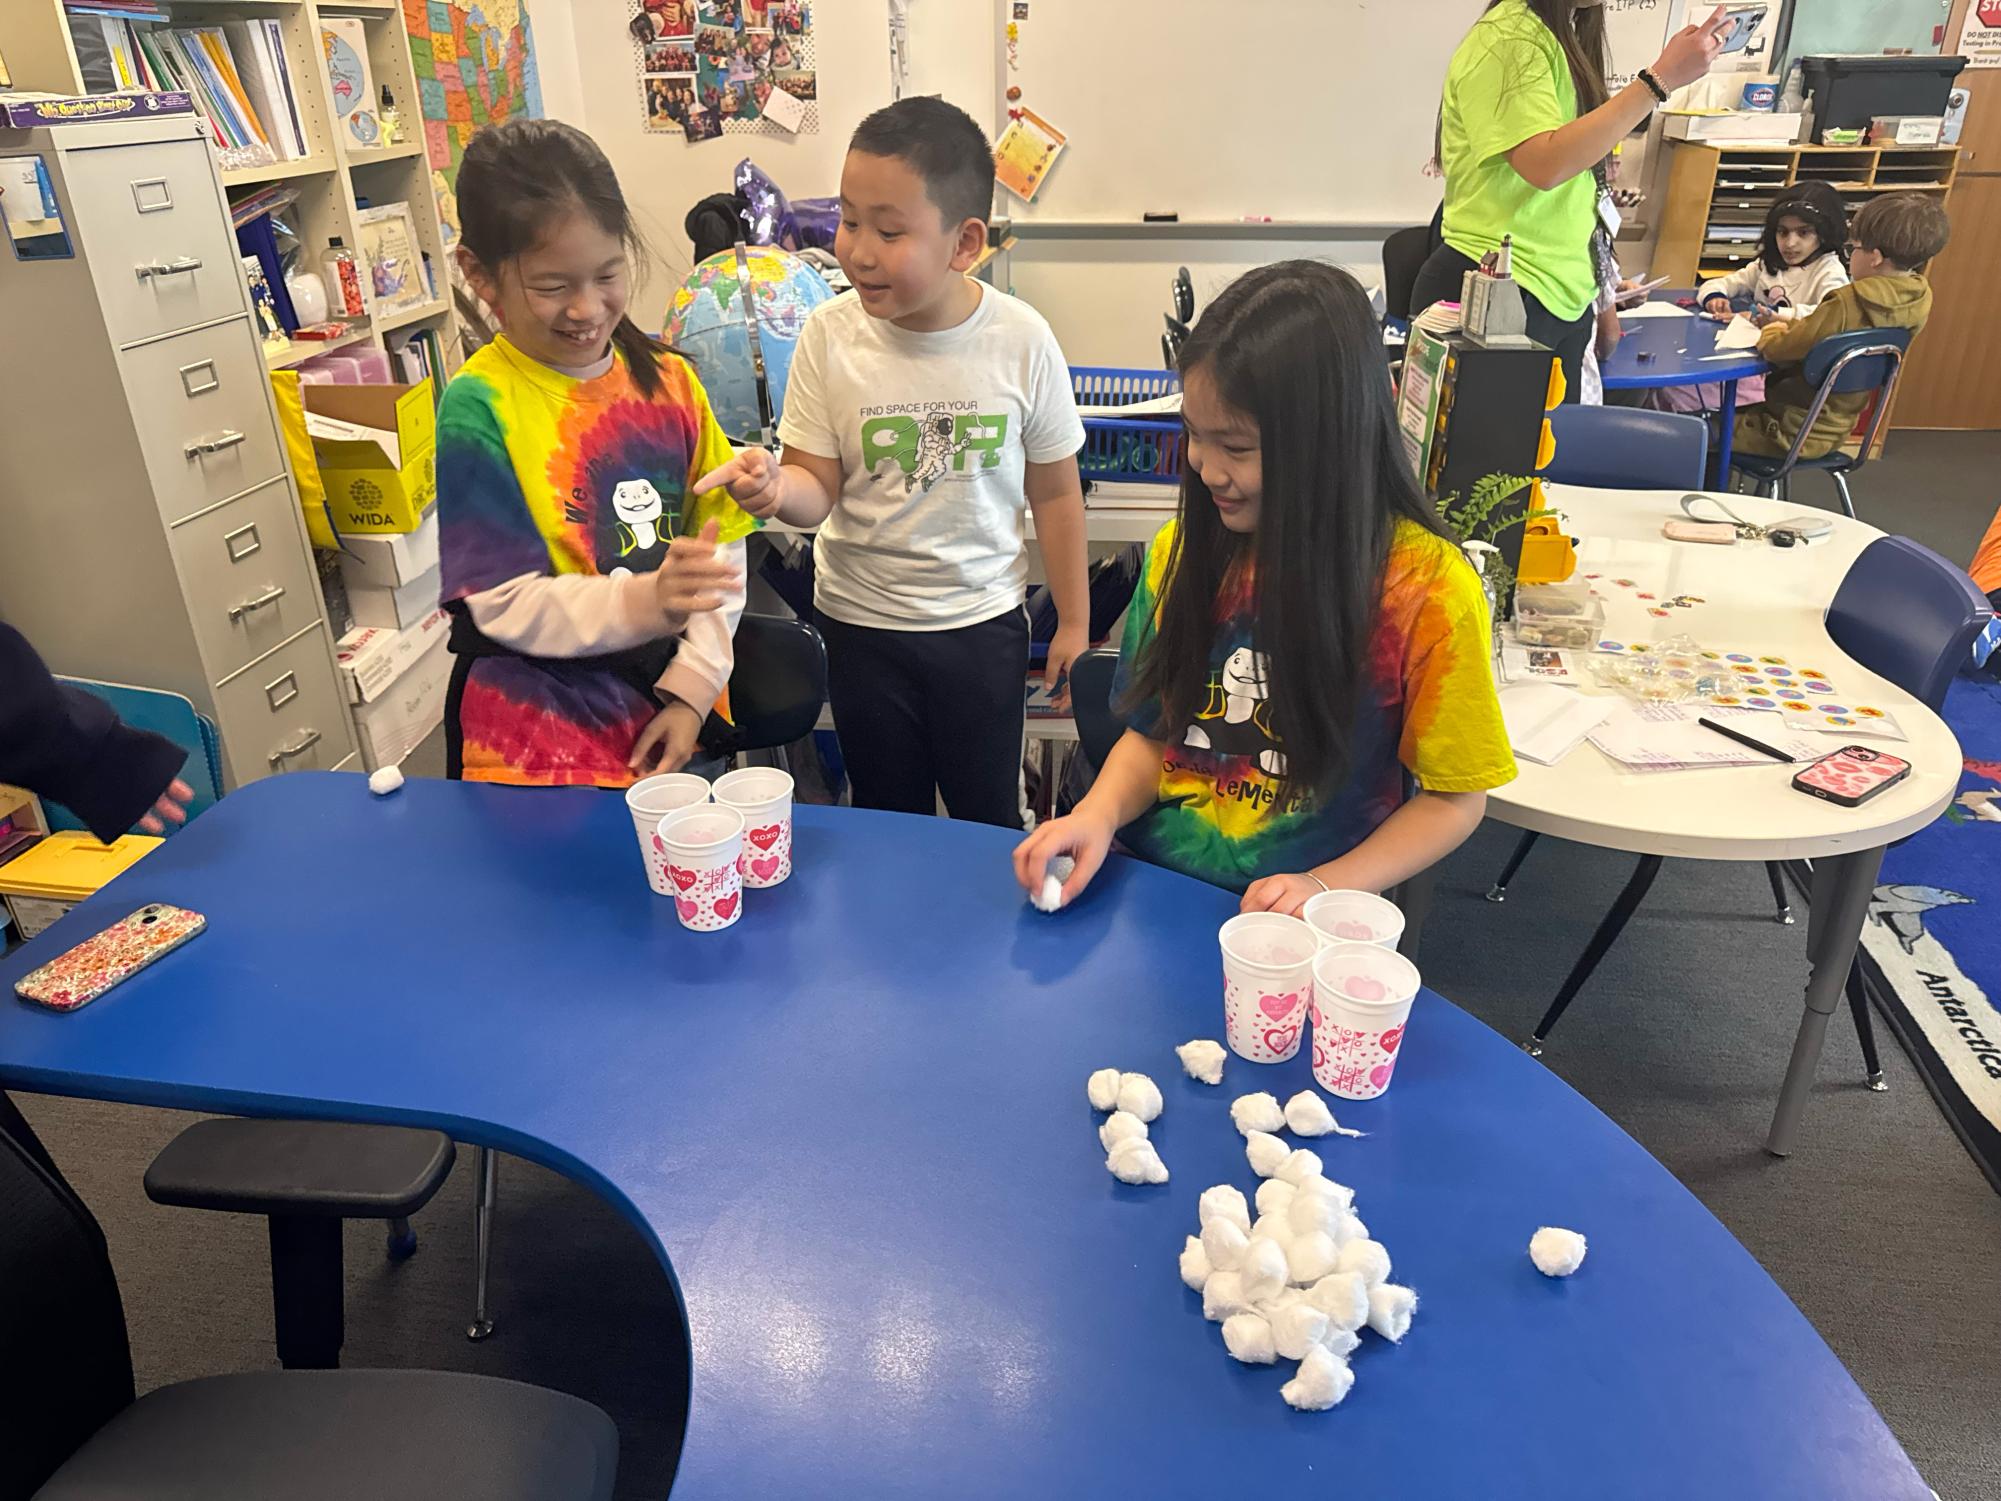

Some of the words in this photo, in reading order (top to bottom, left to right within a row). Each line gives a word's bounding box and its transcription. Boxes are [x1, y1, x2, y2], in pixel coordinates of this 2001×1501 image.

[860, 407, 884, 417] FIND
[886, 403, 921, 415] SPACE
[923, 402, 945, 412] FOR
[948, 400, 978, 411] YOUR
[349, 513, 395, 526] WIDA
[753, 831, 778, 842] XOXO
